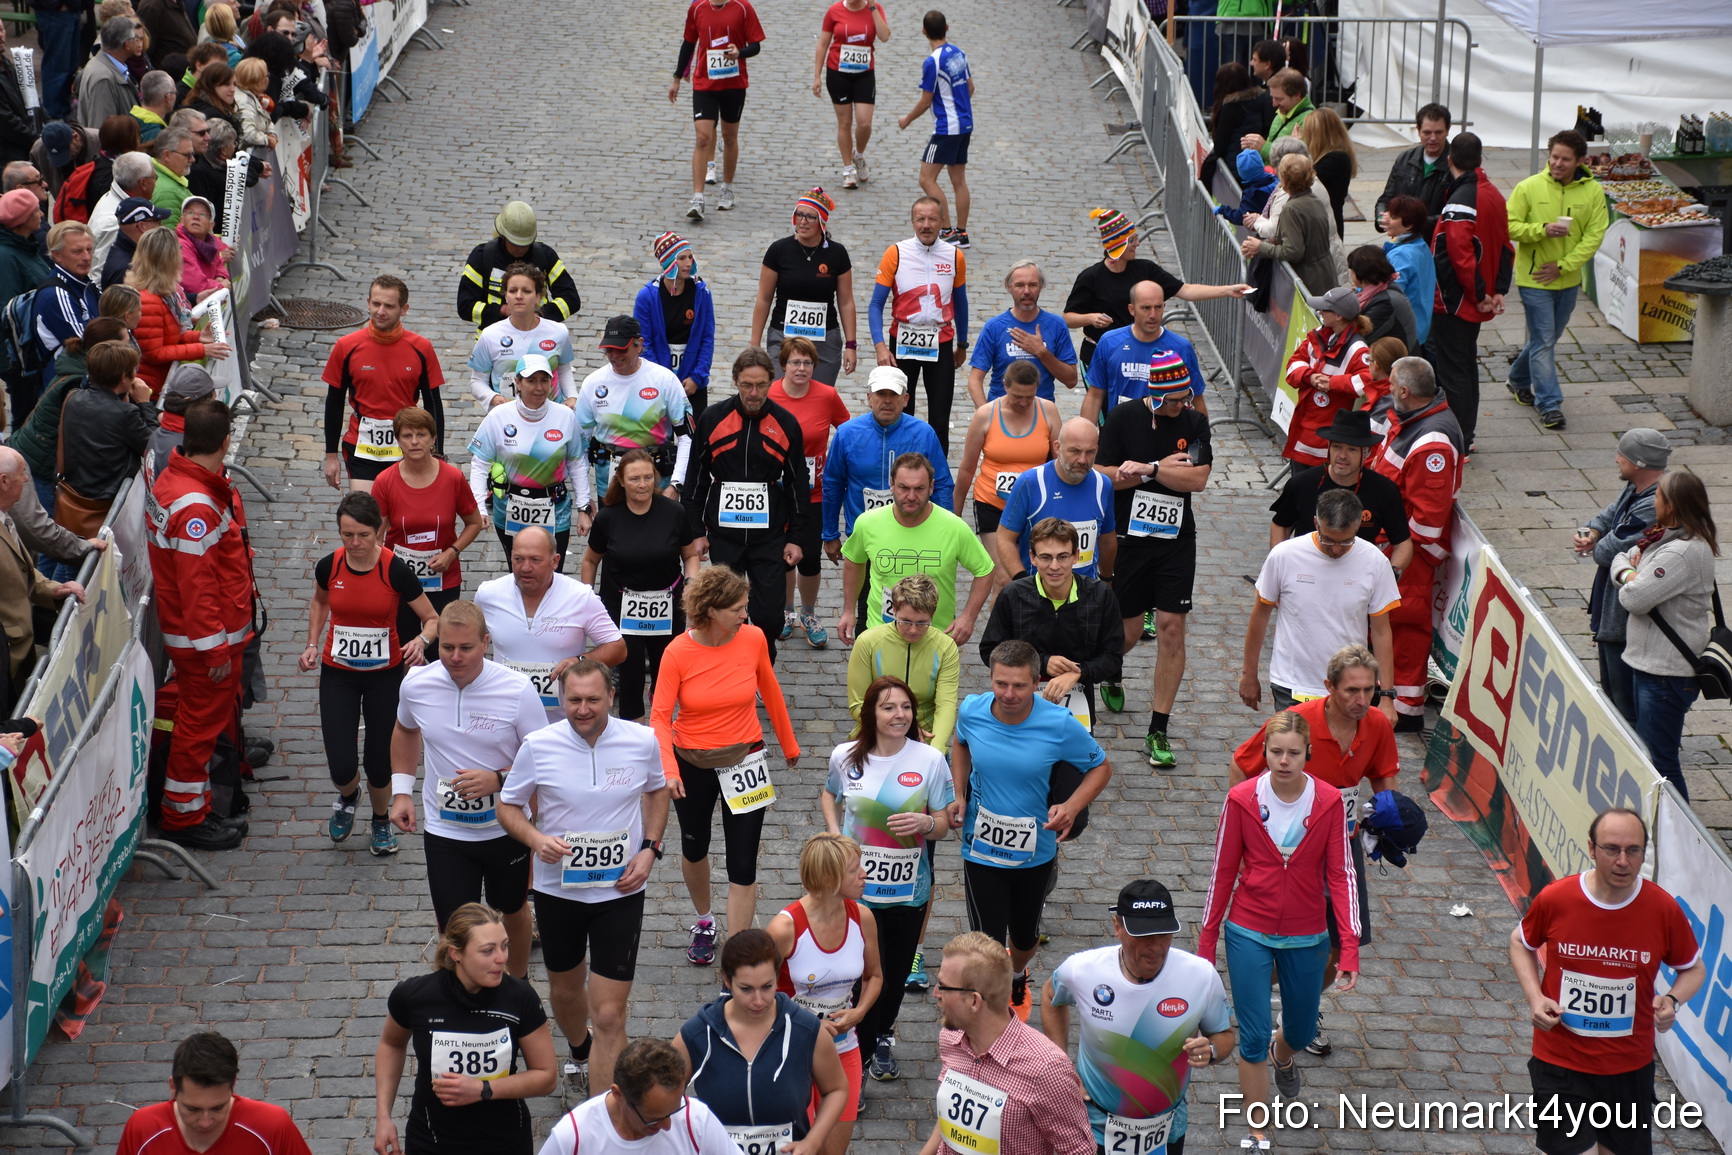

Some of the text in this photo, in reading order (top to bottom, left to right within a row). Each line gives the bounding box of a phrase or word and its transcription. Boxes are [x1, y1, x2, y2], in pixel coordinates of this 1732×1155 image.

[843, 51, 869, 64] 2430
[224, 165, 236, 210] Laufsport
[789, 309, 824, 327] 2460
[900, 331, 935, 348] 2237
[367, 429, 394, 446] 130
[366, 447, 393, 456] Christian
[724, 493, 765, 511] 2563
[511, 505, 551, 525] 3027
[735, 514, 754, 522] Klaus
[1135, 502, 1179, 526] 2458
[626, 600, 669, 619] 2562
[334, 629, 352, 637] PARTL
[638, 621, 656, 631] Gaby
[337, 638, 382, 658] 2041
[520, 666, 549, 674] Neumarkt
[465, 714, 500, 734] Julia
[737, 756, 763, 770] Neumarkt
[601, 766, 635, 793] Julia
[731, 765, 767, 793] 304
[741, 789, 769, 806] Claudia
[455, 813, 487, 822] Manuel
[979, 811, 1027, 829] PARTL Neumarkt
[565, 836, 620, 844] PARTL Neumarkt
[980, 822, 1032, 849] 2027
[570, 844, 625, 868] 2593
[860, 850, 882, 859] PARTL
[990, 848, 1013, 860] Franz
[587, 871, 606, 882] Sigi
[864, 860, 914, 882] 2503
[875, 886, 897, 896] Anita
[1132, 901, 1161, 909] CRAFT
[1558, 942, 1639, 962] NEUMARKT
[1564, 975, 1625, 991] PARTL Neumarkt
[793, 997, 817, 1009] PARTL
[1161, 1002, 1185, 1012] Hervis
[1567, 987, 1627, 1015] 2501
[1091, 1006, 1114, 1018] PARTL
[1091, 1012, 1114, 1022] Neumarkt
[1583, 1018, 1611, 1029] Frank
[434, 1039, 499, 1048] PARTL Neumarkt
[448, 1049, 498, 1076] 385
[944, 1076, 994, 1104] PARTL Neumarkt
[947, 1092, 989, 1131] 367
[1108, 1118, 1133, 1131] PARTL
[743, 1131, 780, 1140] Neumarkt
[950, 1127, 978, 1149] Martin
[1112, 1124, 1167, 1155] 2166
